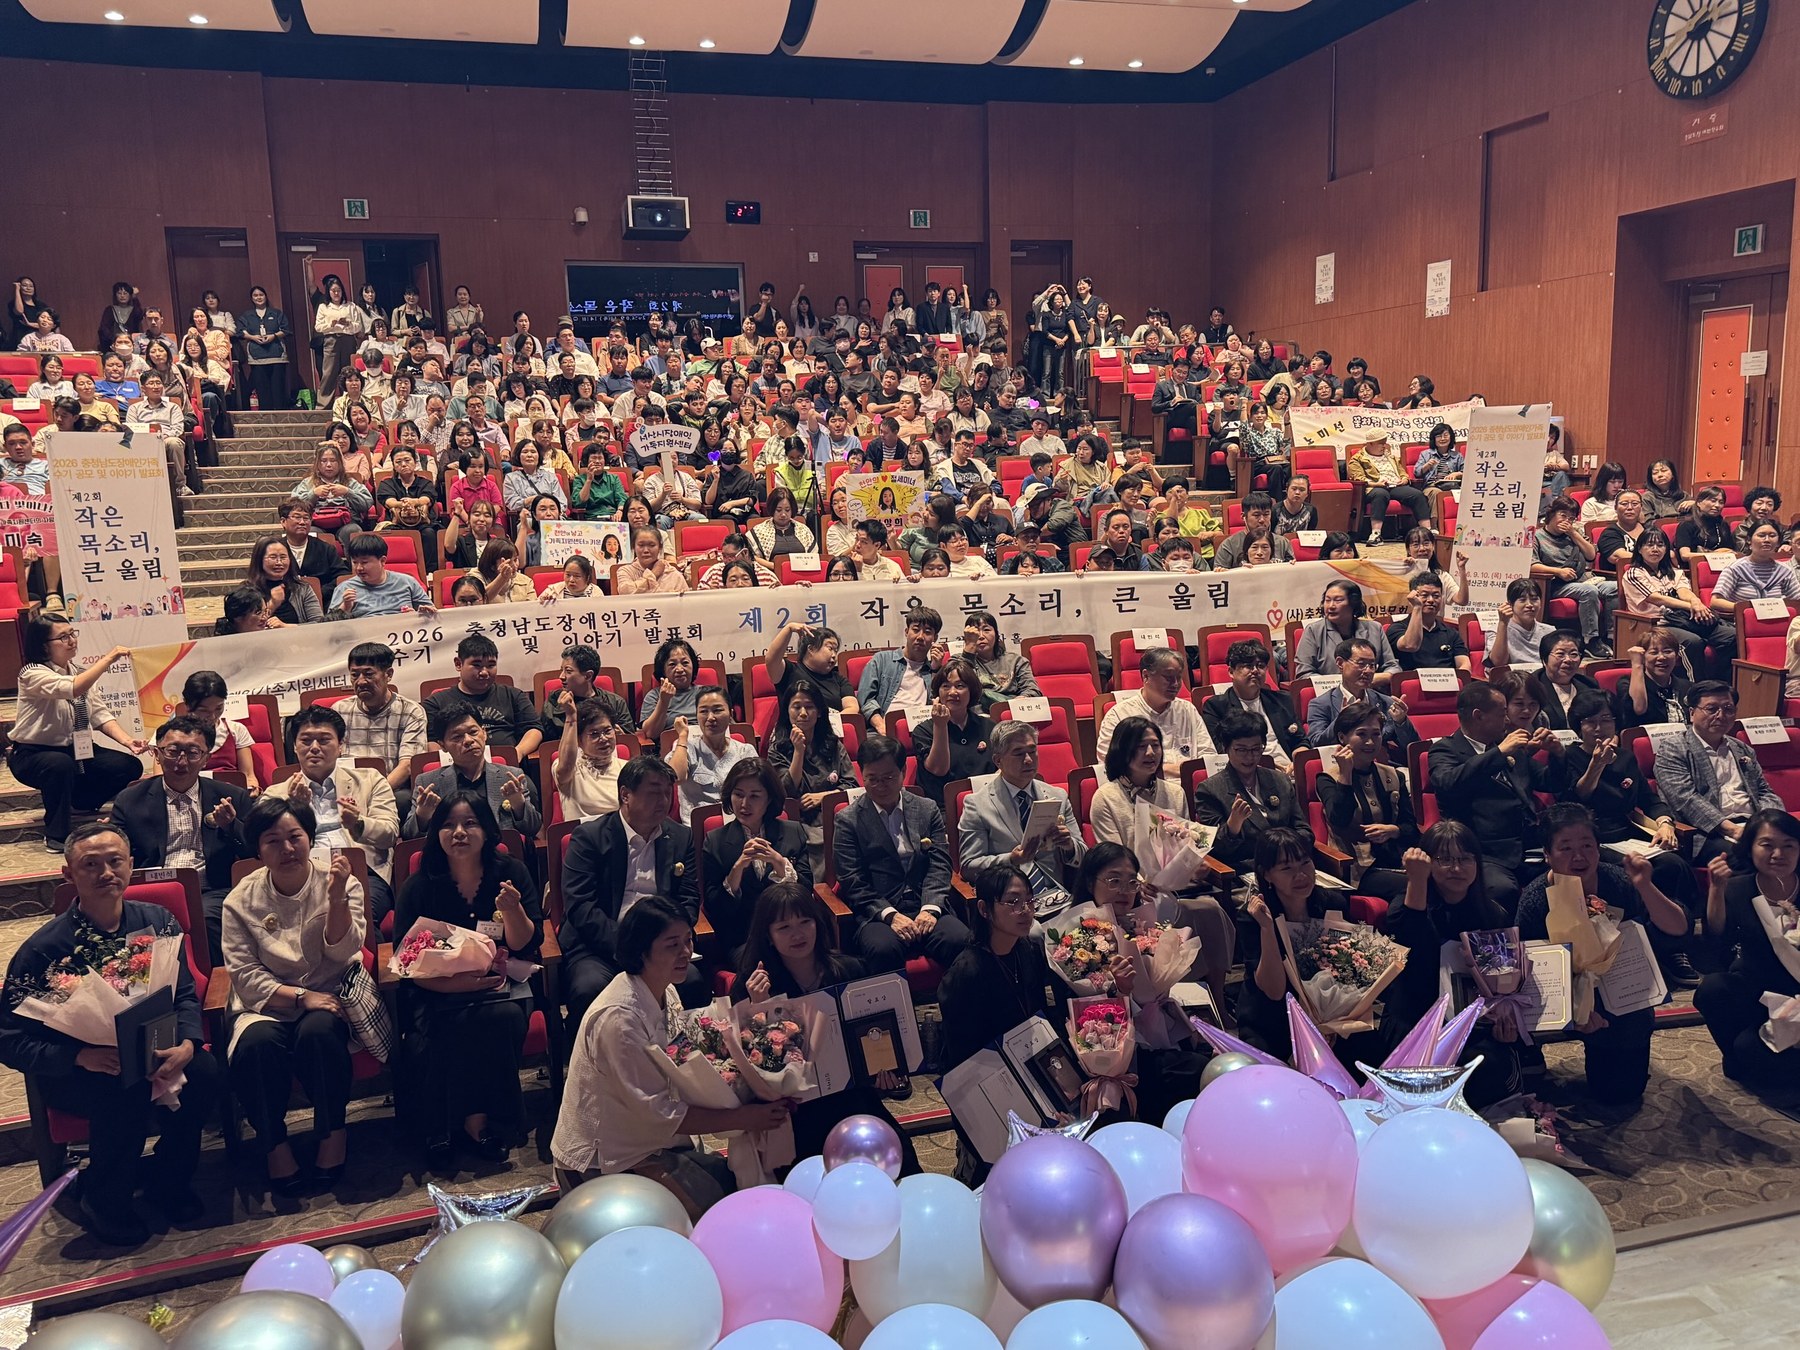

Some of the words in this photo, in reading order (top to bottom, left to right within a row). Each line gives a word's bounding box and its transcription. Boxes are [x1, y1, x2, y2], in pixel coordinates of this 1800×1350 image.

[640, 429, 693, 442] 서산시장애인
[640, 438, 693, 453] 가족지원센터
[53, 458, 78, 468] 2026
[81, 457, 160, 468] 충청남도장애인가족
[1477, 450, 1497, 459] 제2회
[54, 470, 73, 480] 수기
[76, 469, 95, 479] 공모
[97, 468, 107, 479] 및
[109, 468, 136, 479] 이야기
[139, 467, 165, 479] 발표회
[1475, 461, 1508, 478] 작은
[72, 491, 102, 503] 제2회
[1472, 480, 1527, 499] 목소리,
[74, 505, 124, 529] 작은
[1470, 502, 1485, 518] 큰
[1493, 501, 1525, 519] 울림
[77, 531, 160, 556] 목소리,
[81, 561, 106, 583] 큰
[116, 557, 163, 582] 울림
[387, 626, 443, 647] 2026
[465, 608, 662, 638] 충청남도장애인가족
[739, 603, 827, 633] 제2회
[959, 588, 1082, 618] 목소리,
[1112, 586, 1140, 613] 큰
[1168, 580, 1230, 611] 울림
[521, 635, 540, 655] 및
[644, 623, 704, 645] 발표회
